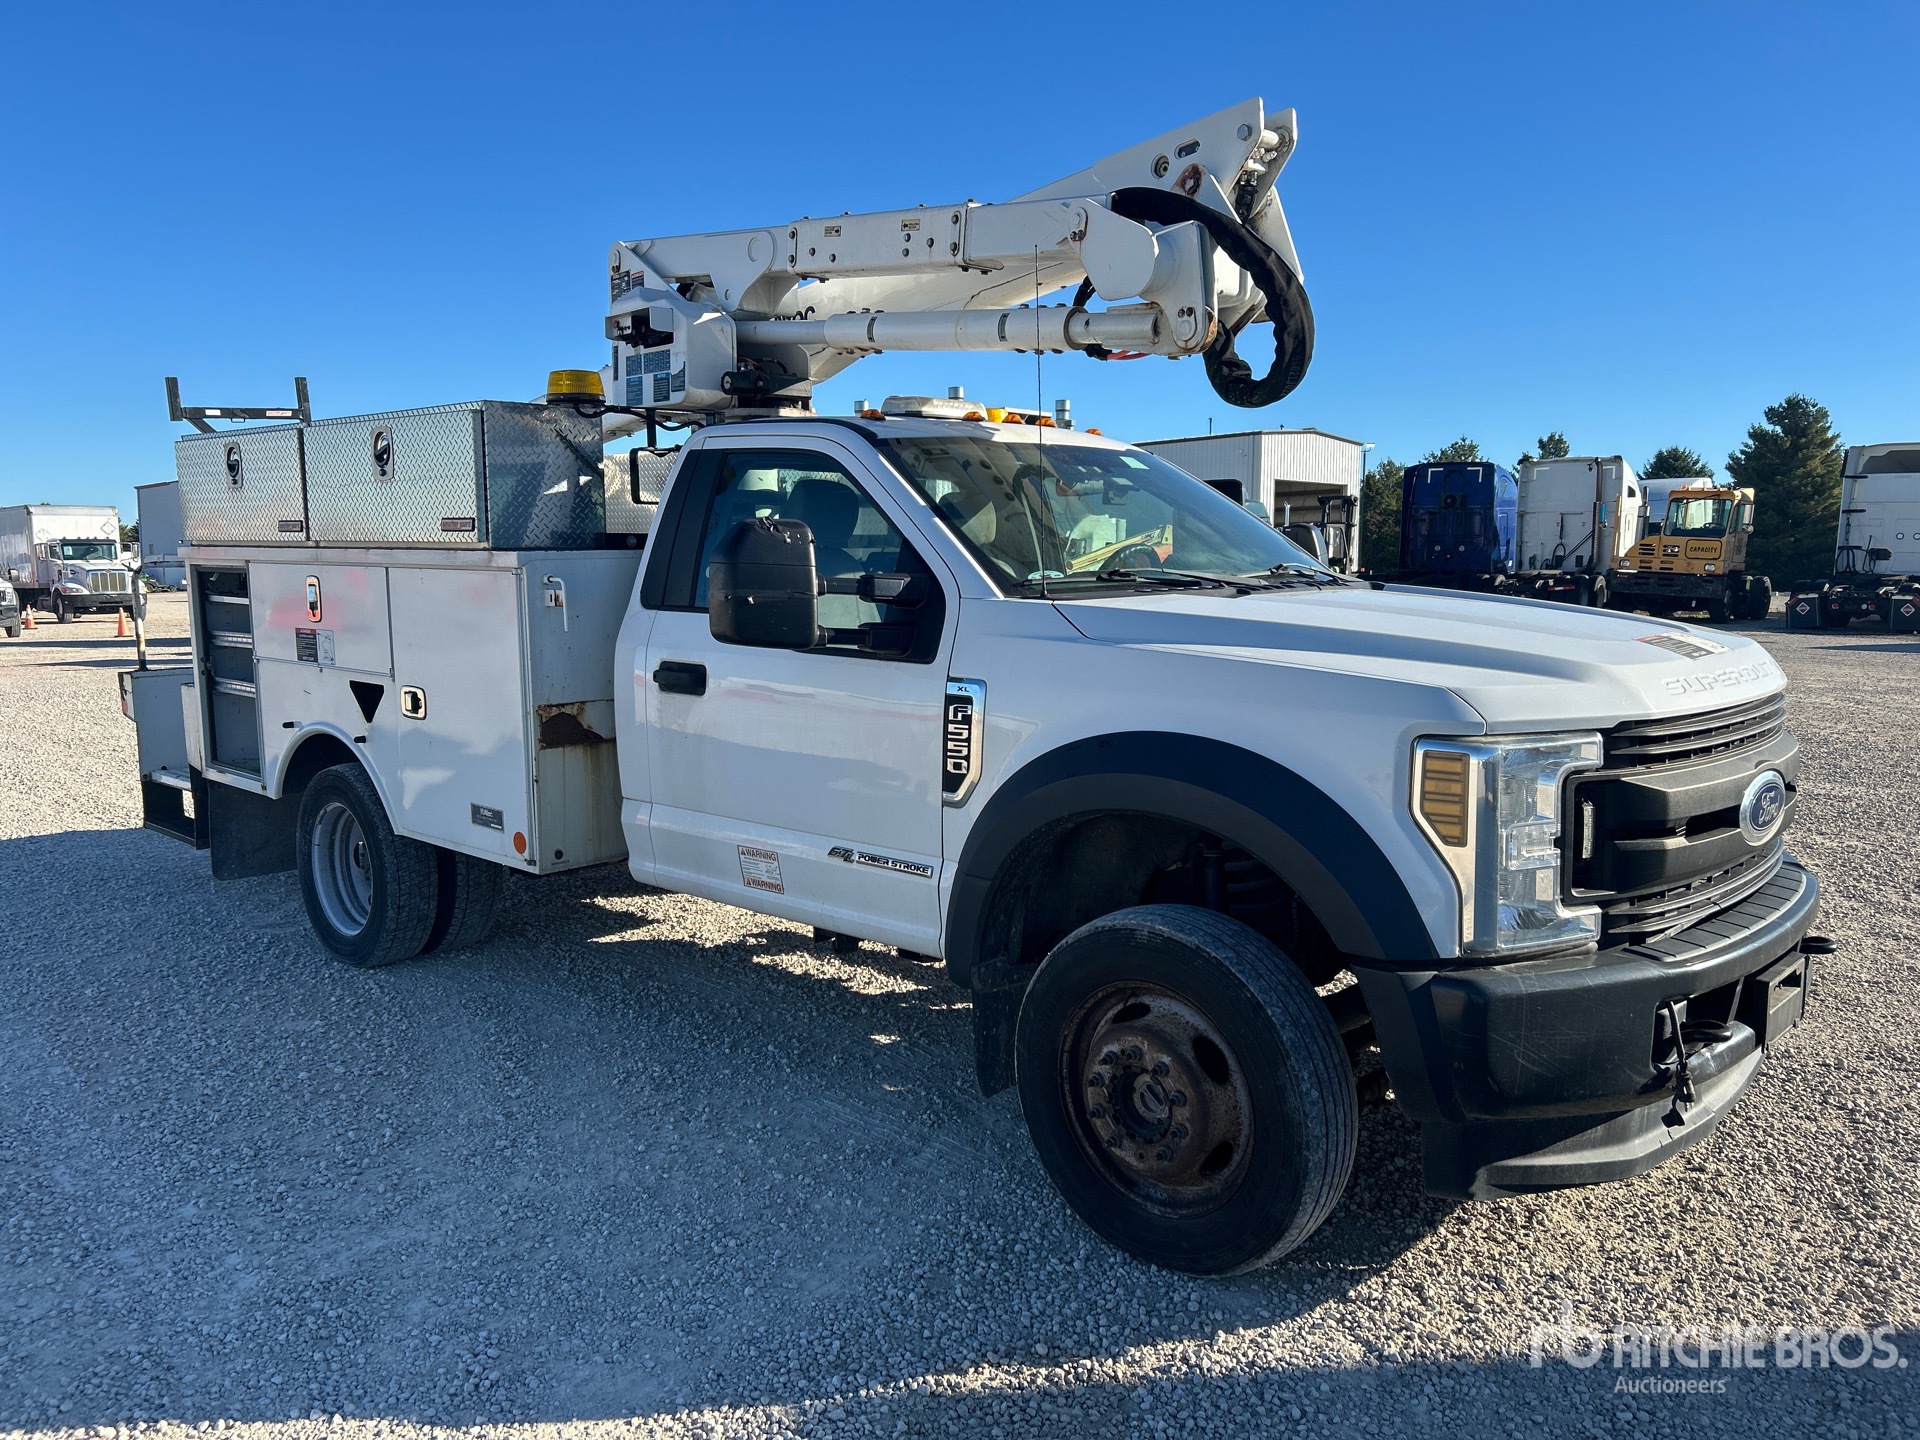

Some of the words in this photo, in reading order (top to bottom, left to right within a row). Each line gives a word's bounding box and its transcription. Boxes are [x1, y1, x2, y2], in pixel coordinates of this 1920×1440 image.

[1759, 790, 1780, 825] Ford
[745, 848, 777, 861] WARNING
[858, 853, 889, 866] POWER
[891, 860, 929, 874] STROKE
[750, 878, 782, 892] WARNING
